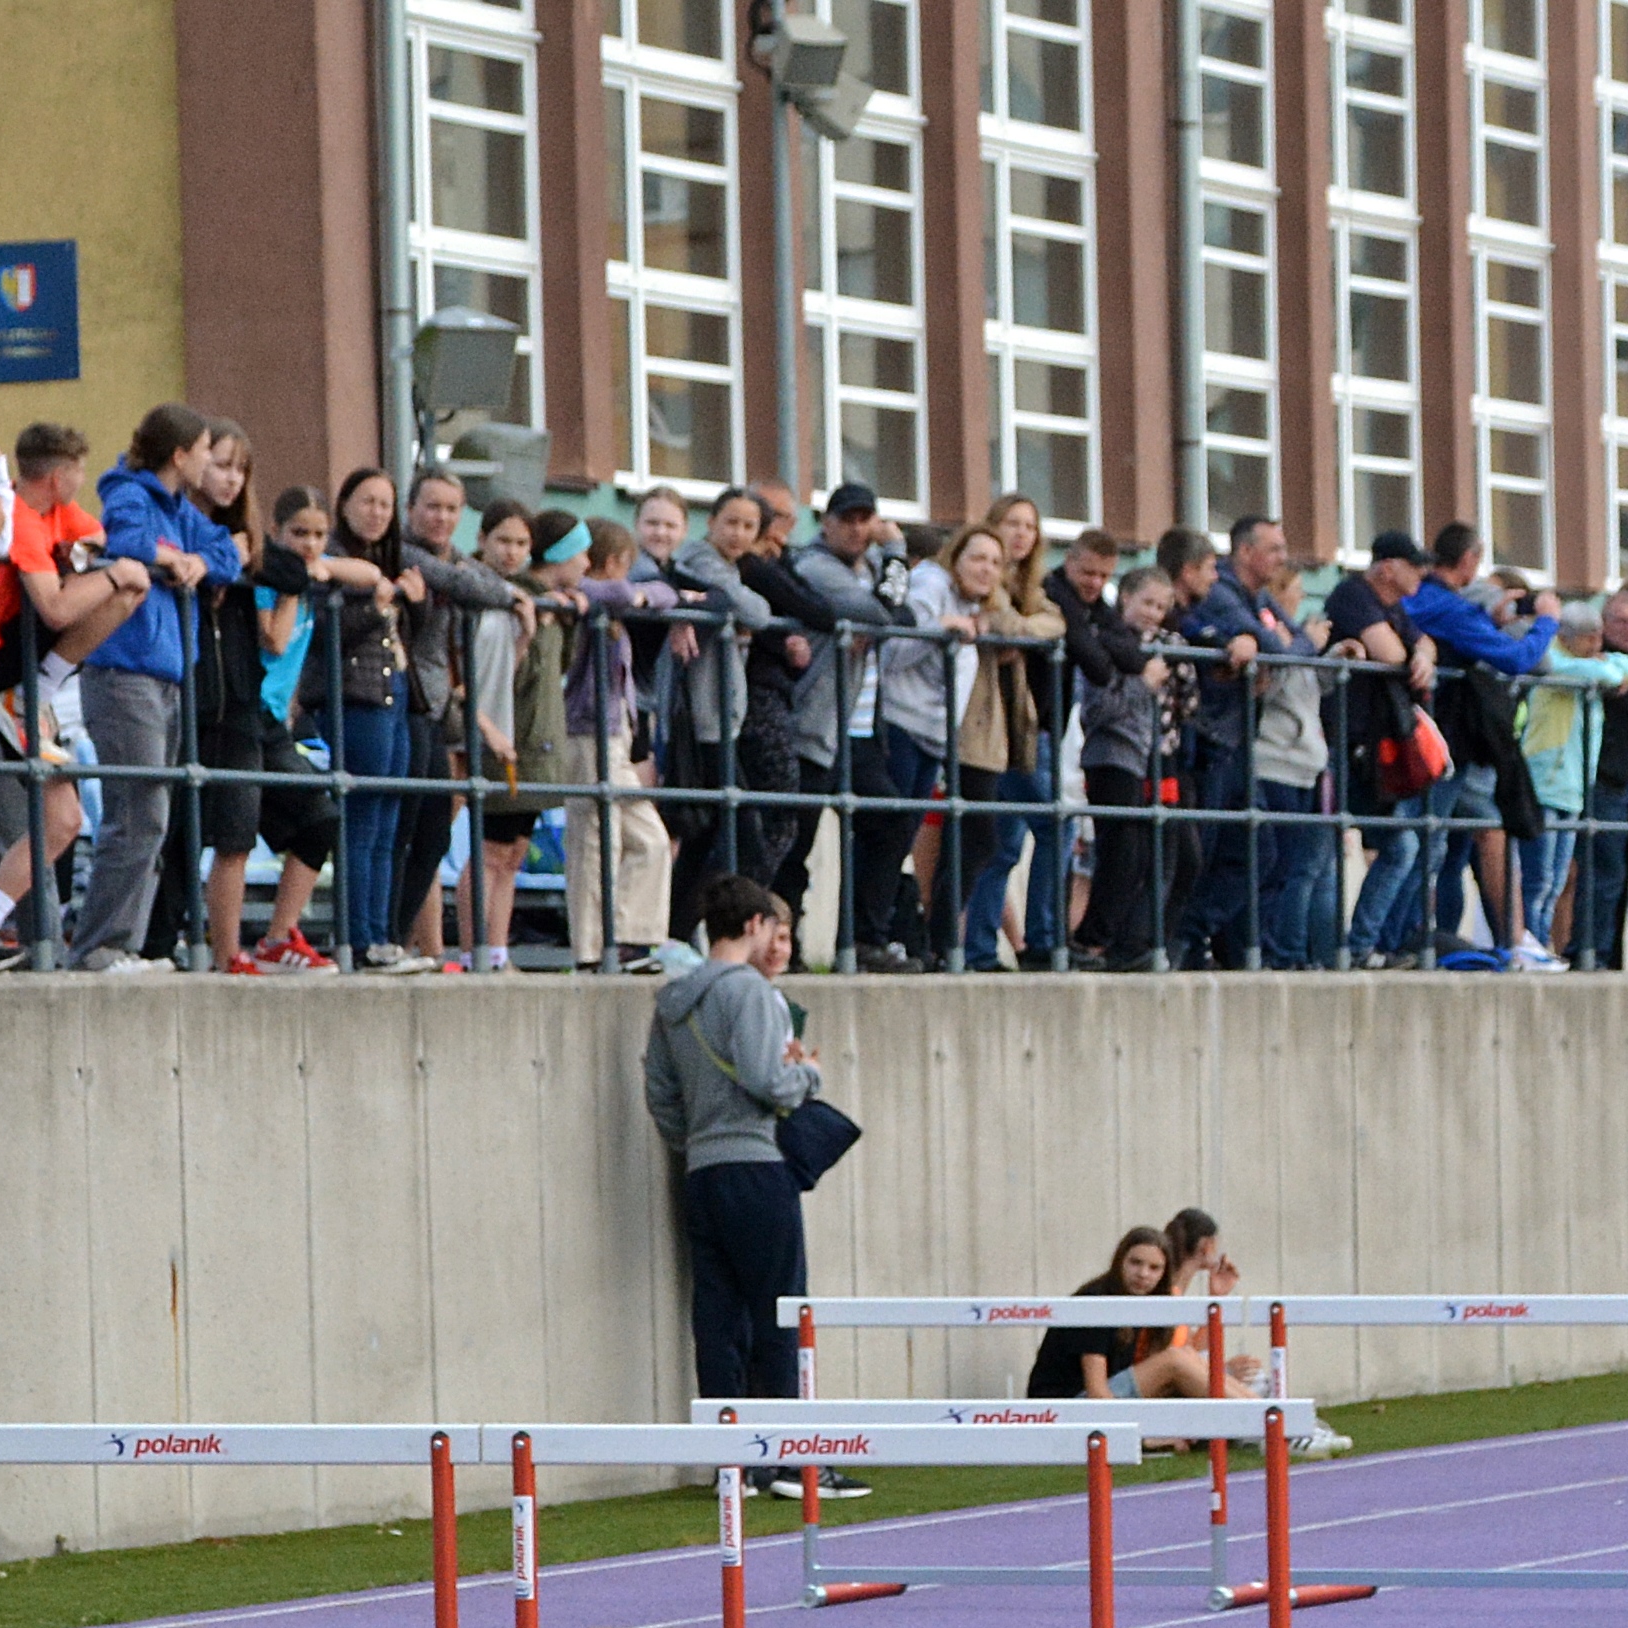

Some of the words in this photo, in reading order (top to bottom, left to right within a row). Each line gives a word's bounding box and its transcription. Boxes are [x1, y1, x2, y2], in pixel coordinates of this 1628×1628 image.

[988, 1304, 1052, 1321] polanik
[1463, 1302, 1528, 1320] polanik
[134, 1433, 221, 1458] polanik
[778, 1434, 870, 1458] polanik
